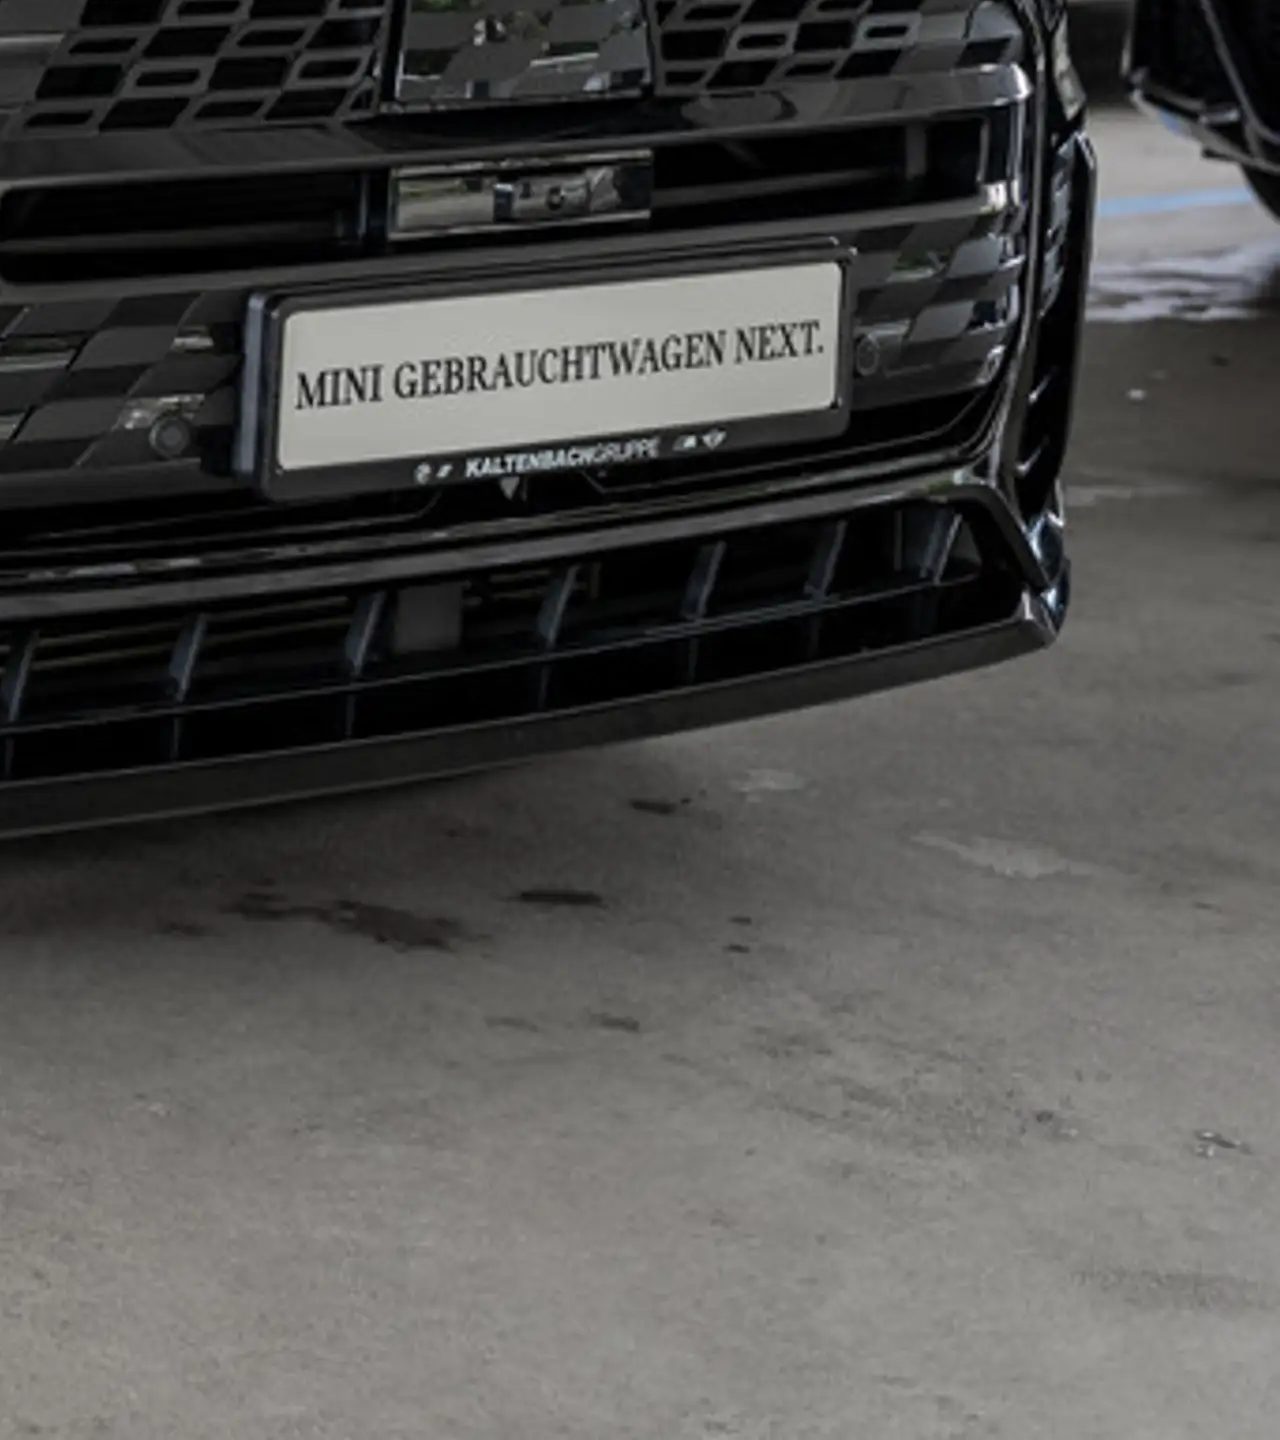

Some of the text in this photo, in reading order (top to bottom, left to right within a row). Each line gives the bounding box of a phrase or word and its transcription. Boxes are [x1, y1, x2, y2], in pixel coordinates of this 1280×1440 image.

[295, 319, 824, 410] MINI GEBRAUCHTWAGEN NEXT.
